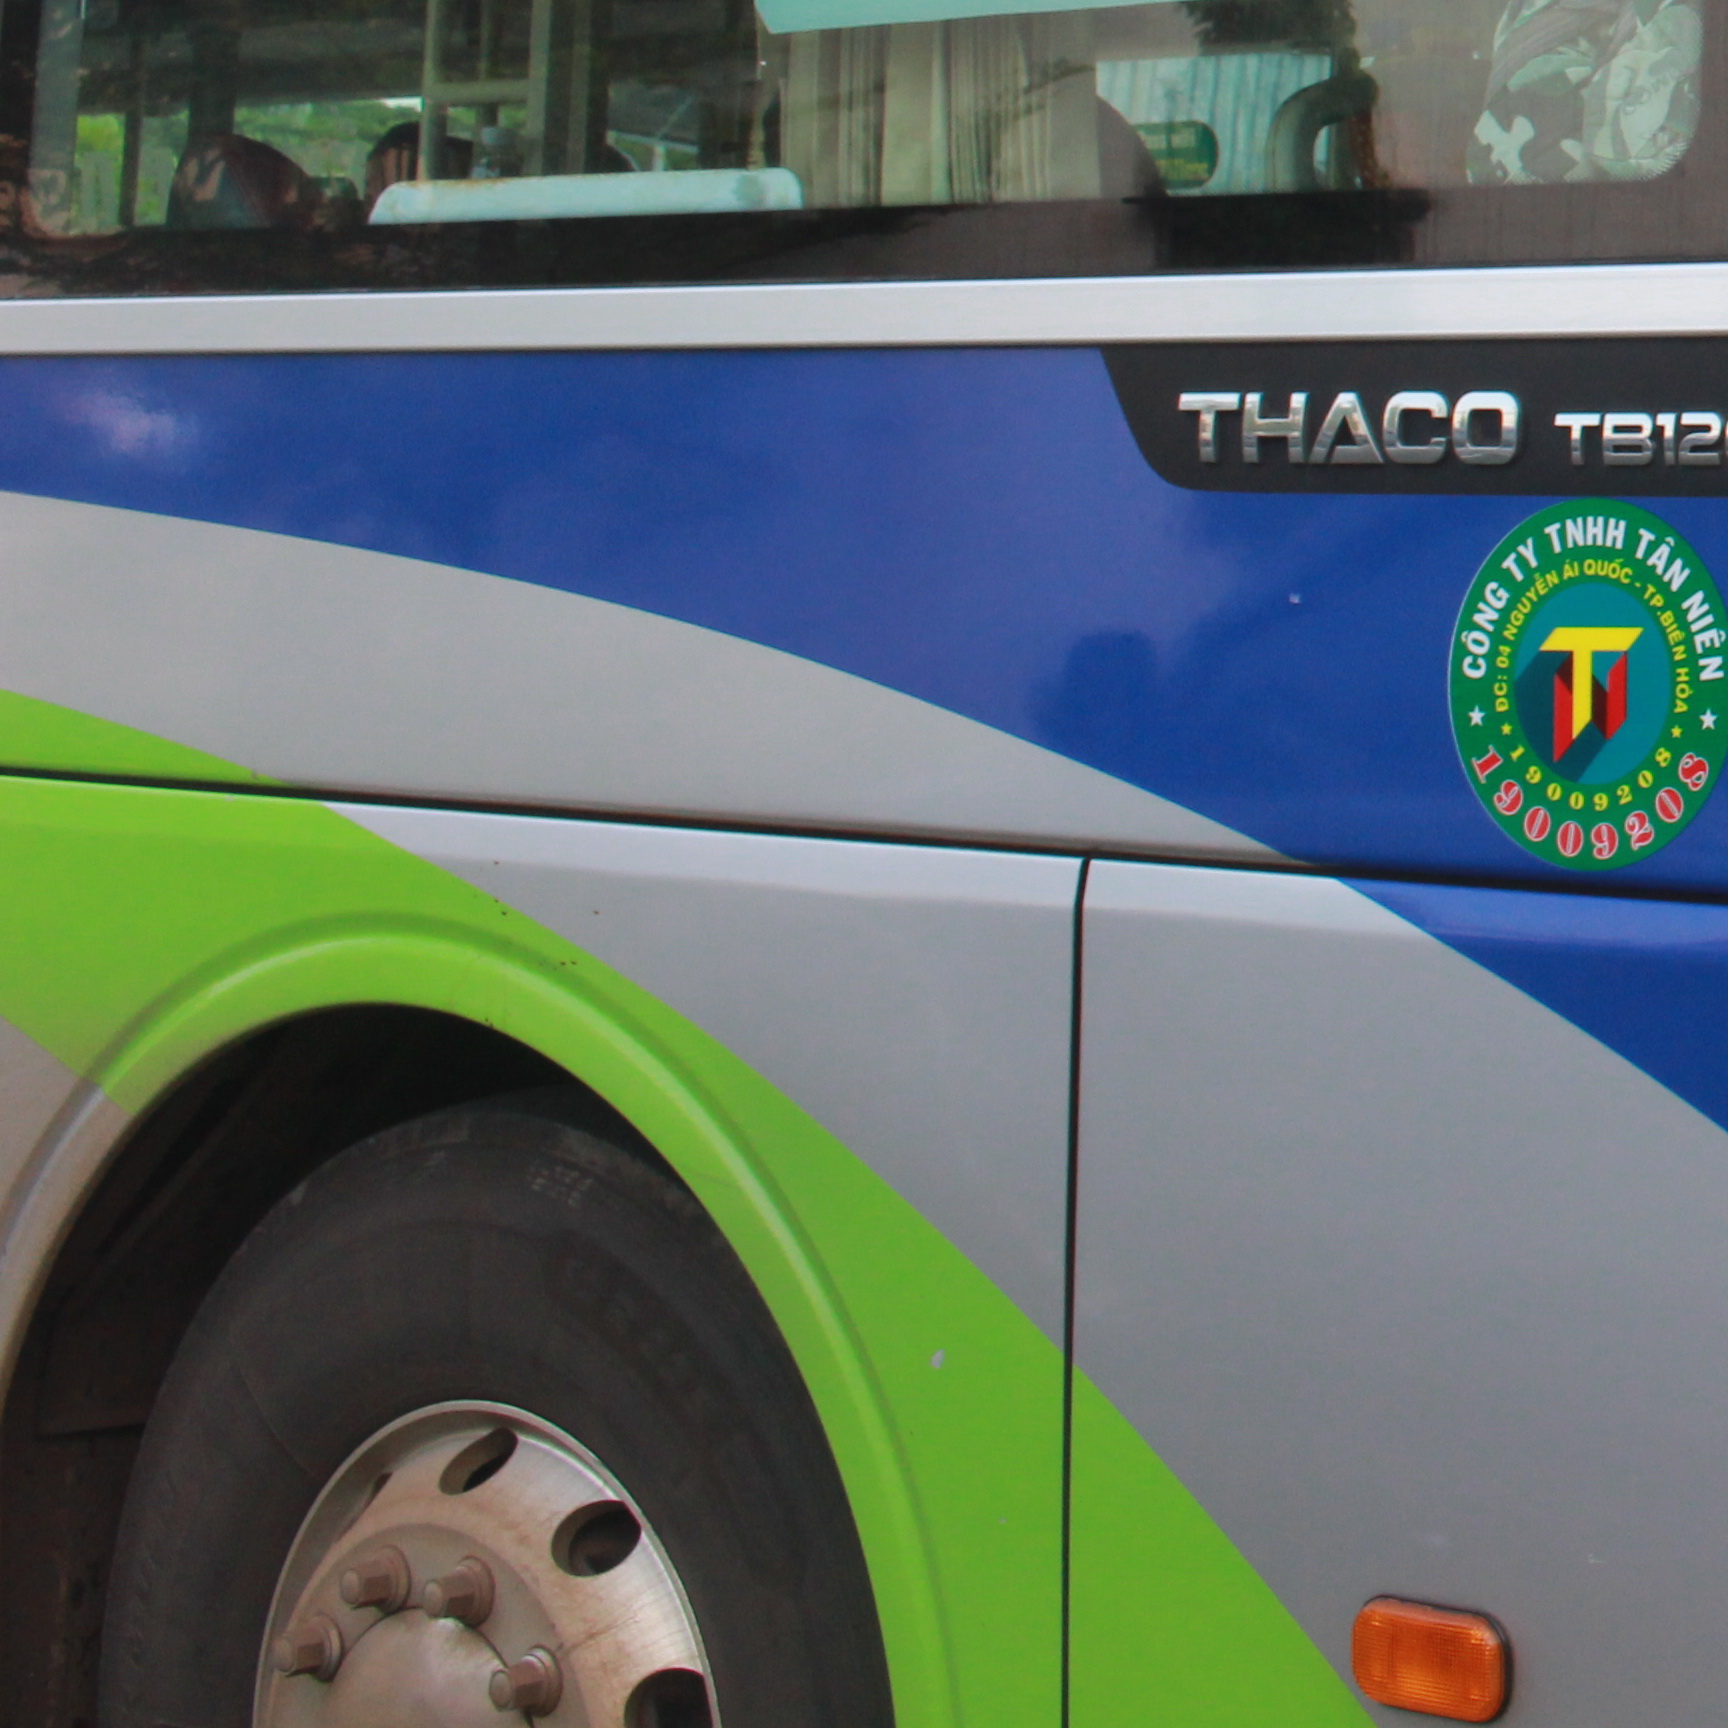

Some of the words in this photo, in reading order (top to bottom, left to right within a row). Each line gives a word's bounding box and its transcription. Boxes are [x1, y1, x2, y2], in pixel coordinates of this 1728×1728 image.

[1177, 391, 1520, 465] THACO
[1460, 580, 1511, 680] CÔNG
[1501, 537, 1538, 583] TY
[1543, 515, 1627, 554] TNHH
[1635, 528, 1691, 593] TÂN
[1681, 590, 1727, 682] NIÊN
[1503, 570, 1560, 641] NGUYỄN
[1562, 559, 1580, 581] ÁI
[1583, 558, 1633, 584] QUỐC
